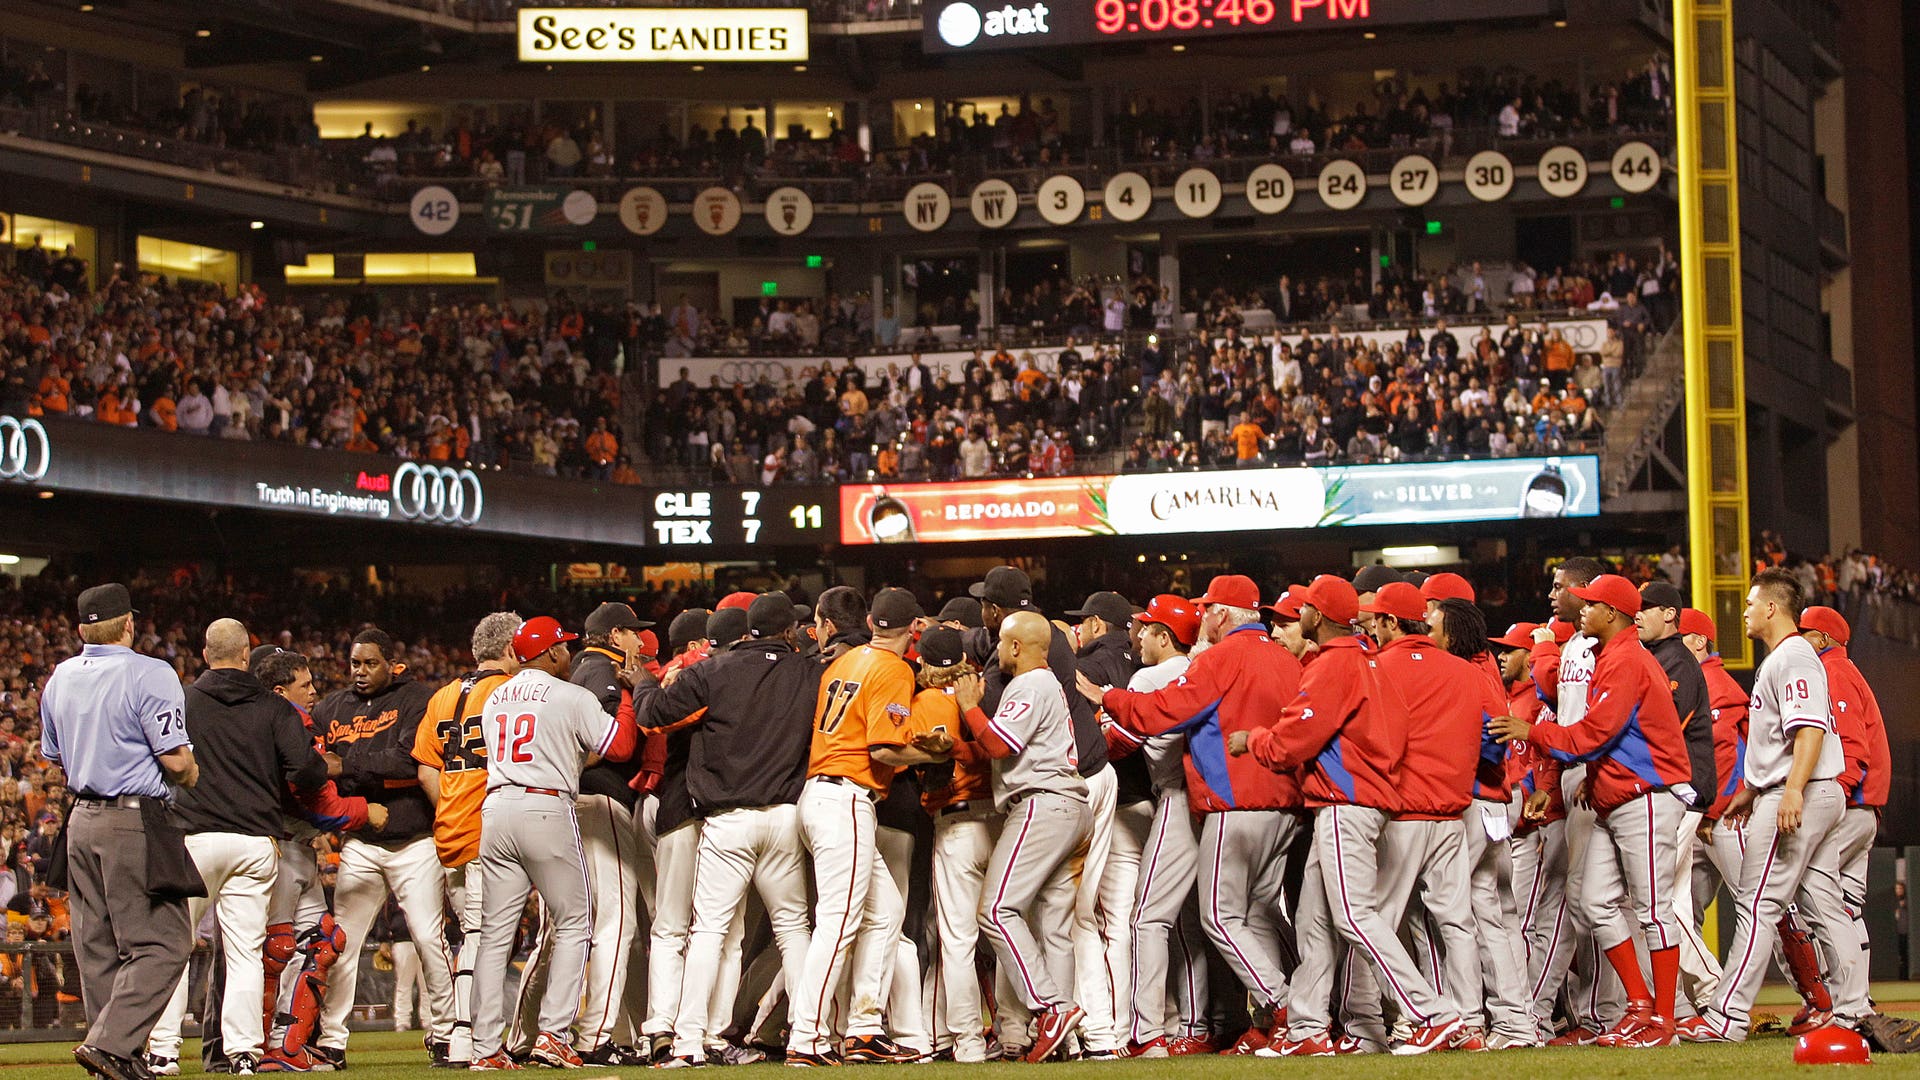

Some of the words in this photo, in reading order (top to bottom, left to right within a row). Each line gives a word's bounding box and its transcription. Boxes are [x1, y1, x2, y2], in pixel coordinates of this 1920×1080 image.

[984, 3, 1049, 36] at&t
[1095, 0, 1275, 34] 9:08:46
[1291, 0, 1370, 22] PM
[533, 15, 635, 50] See's
[651, 27, 788, 50] CANDIES
[1475, 166, 1504, 186] 30
[1547, 161, 1578, 182] 36
[1619, 156, 1652, 177] 44
[1255, 178, 1285, 199] 20
[1327, 174, 1358, 195] 24
[1400, 170, 1429, 191] 27
[1054, 190, 1068, 210] 3
[1118, 186, 1134, 207] 4
[1188, 182, 1206, 203] 11
[419, 200, 450, 221] 42
[917, 202, 938, 223] NY
[983, 198, 1005, 220] NY
[356, 471, 390, 491] Audi
[256, 482, 295, 505] Truth
[295, 486, 310, 506] in
[310, 488, 390, 518] Engineering
[1396, 483, 1473, 502] SILVER
[655, 492, 711, 516] CLE
[741, 491, 761, 515] 7
[944, 501, 1056, 520] REPOSADO
[790, 505, 822, 528] 11
[653, 520, 712, 544] TEX
[742, 519, 761, 543] 7
[1560, 660, 1592, 683] llies
[492, 683, 551, 705] SAMUEL
[818, 678, 862, 735] 17
[999, 701, 1031, 720] 27
[156, 708, 185, 736] 76
[327, 719, 352, 744] San
[494, 712, 537, 763] 12
